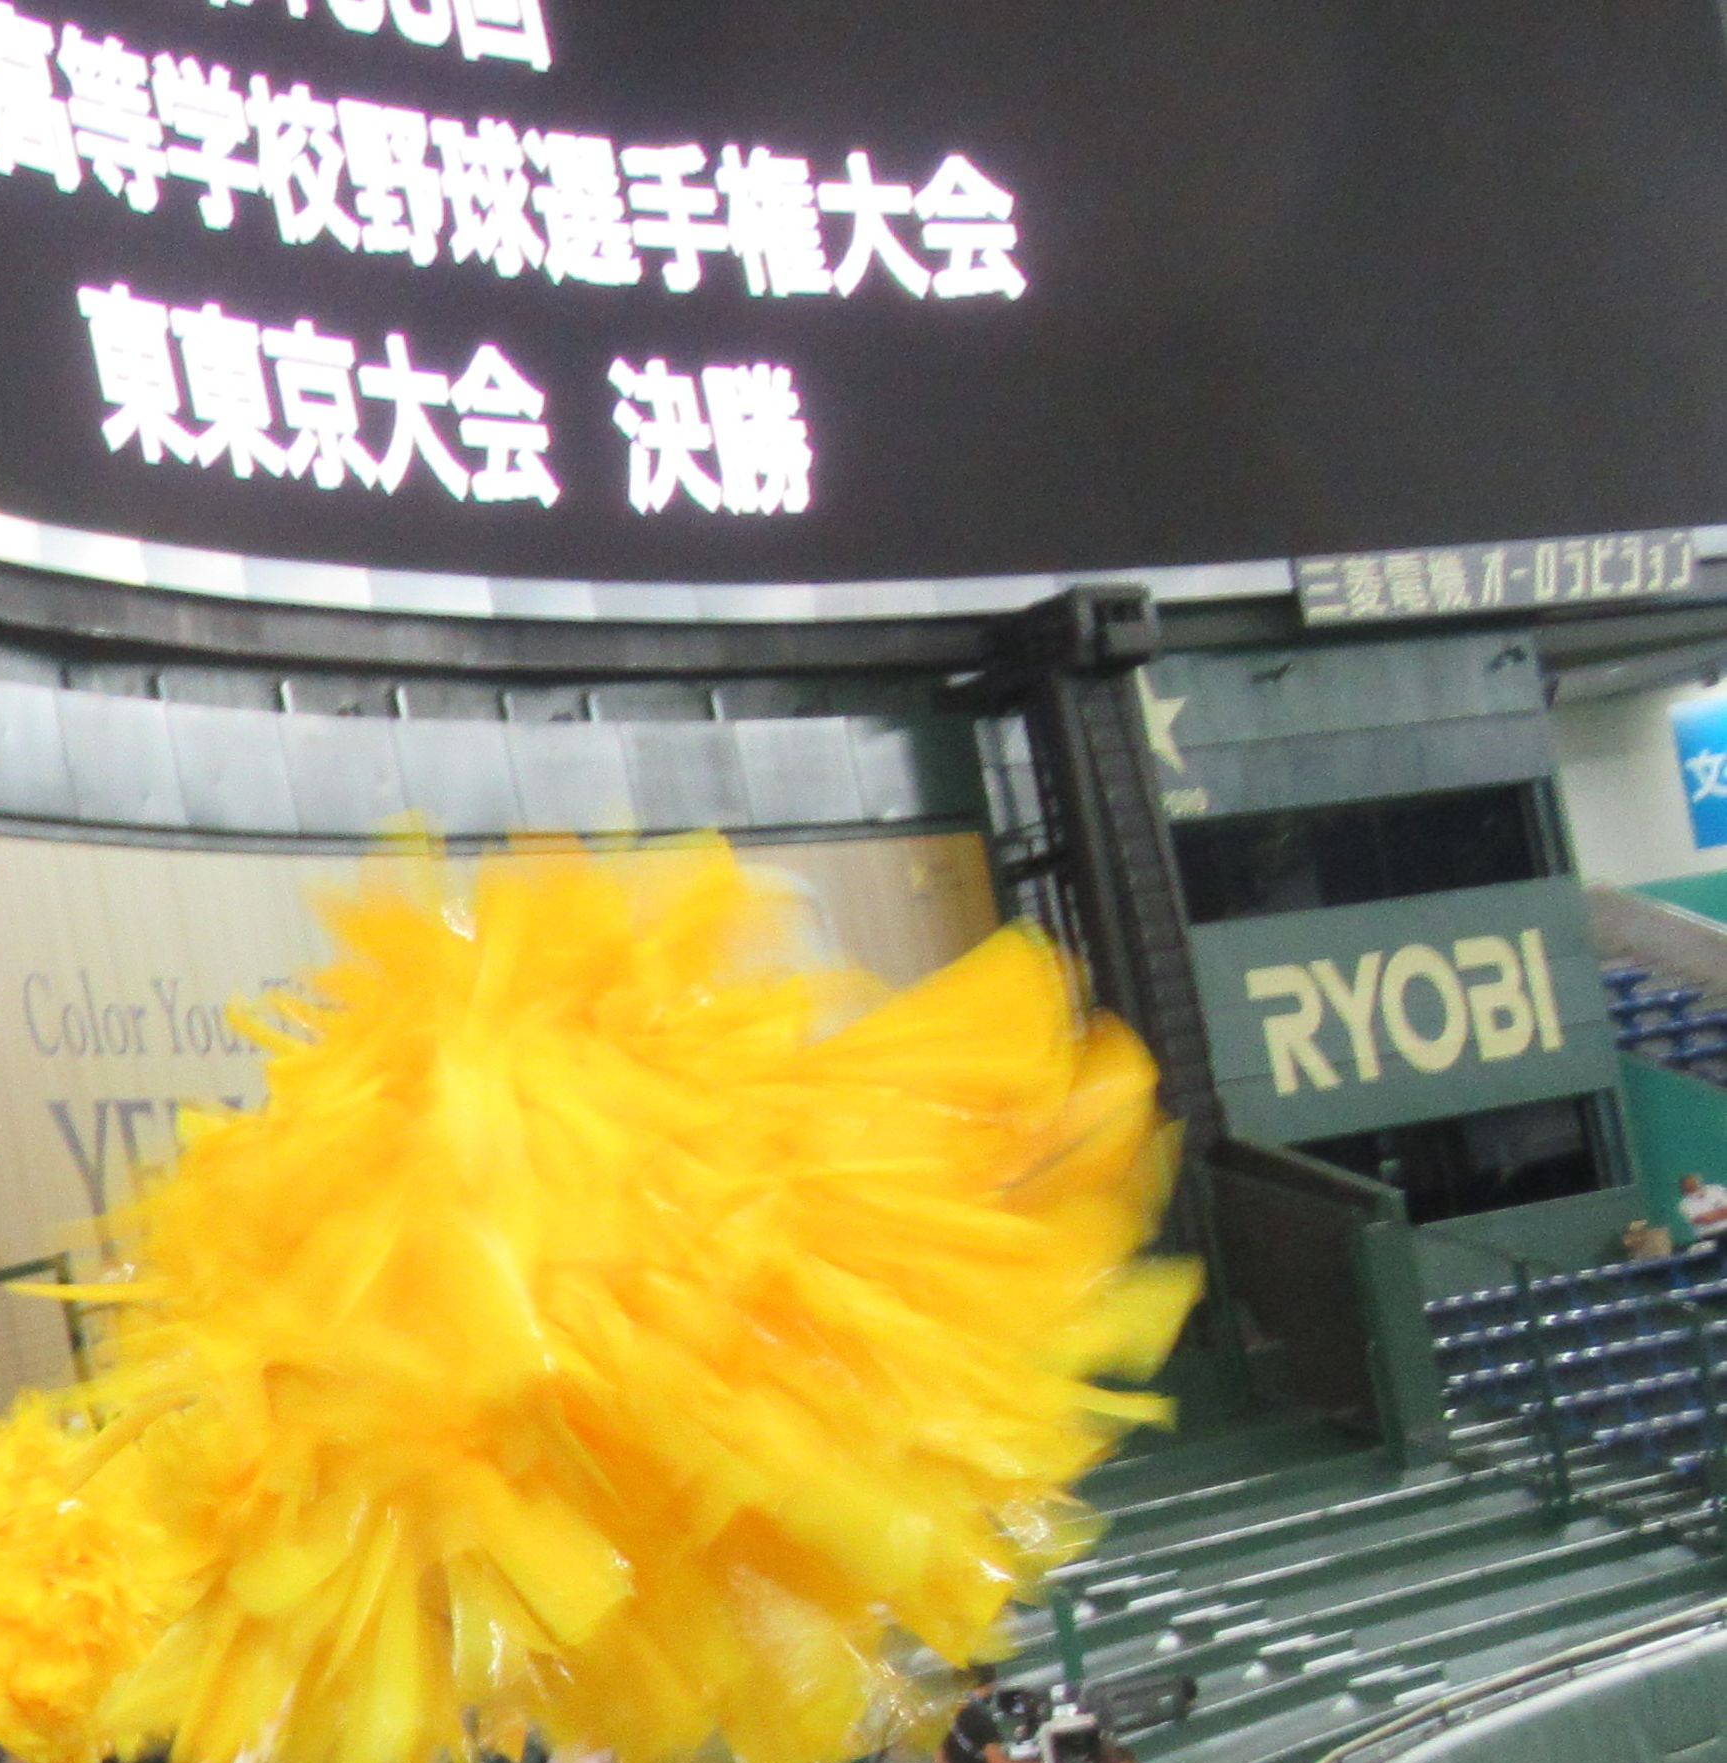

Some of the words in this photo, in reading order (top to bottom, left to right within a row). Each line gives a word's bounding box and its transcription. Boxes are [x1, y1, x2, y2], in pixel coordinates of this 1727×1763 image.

[77, 283, 561, 508] 東東京大会
[607, 356, 813, 516] 決勝
[23, 969, 147, 1057] Color
[1246, 928, 1564, 1097] RYOBI
